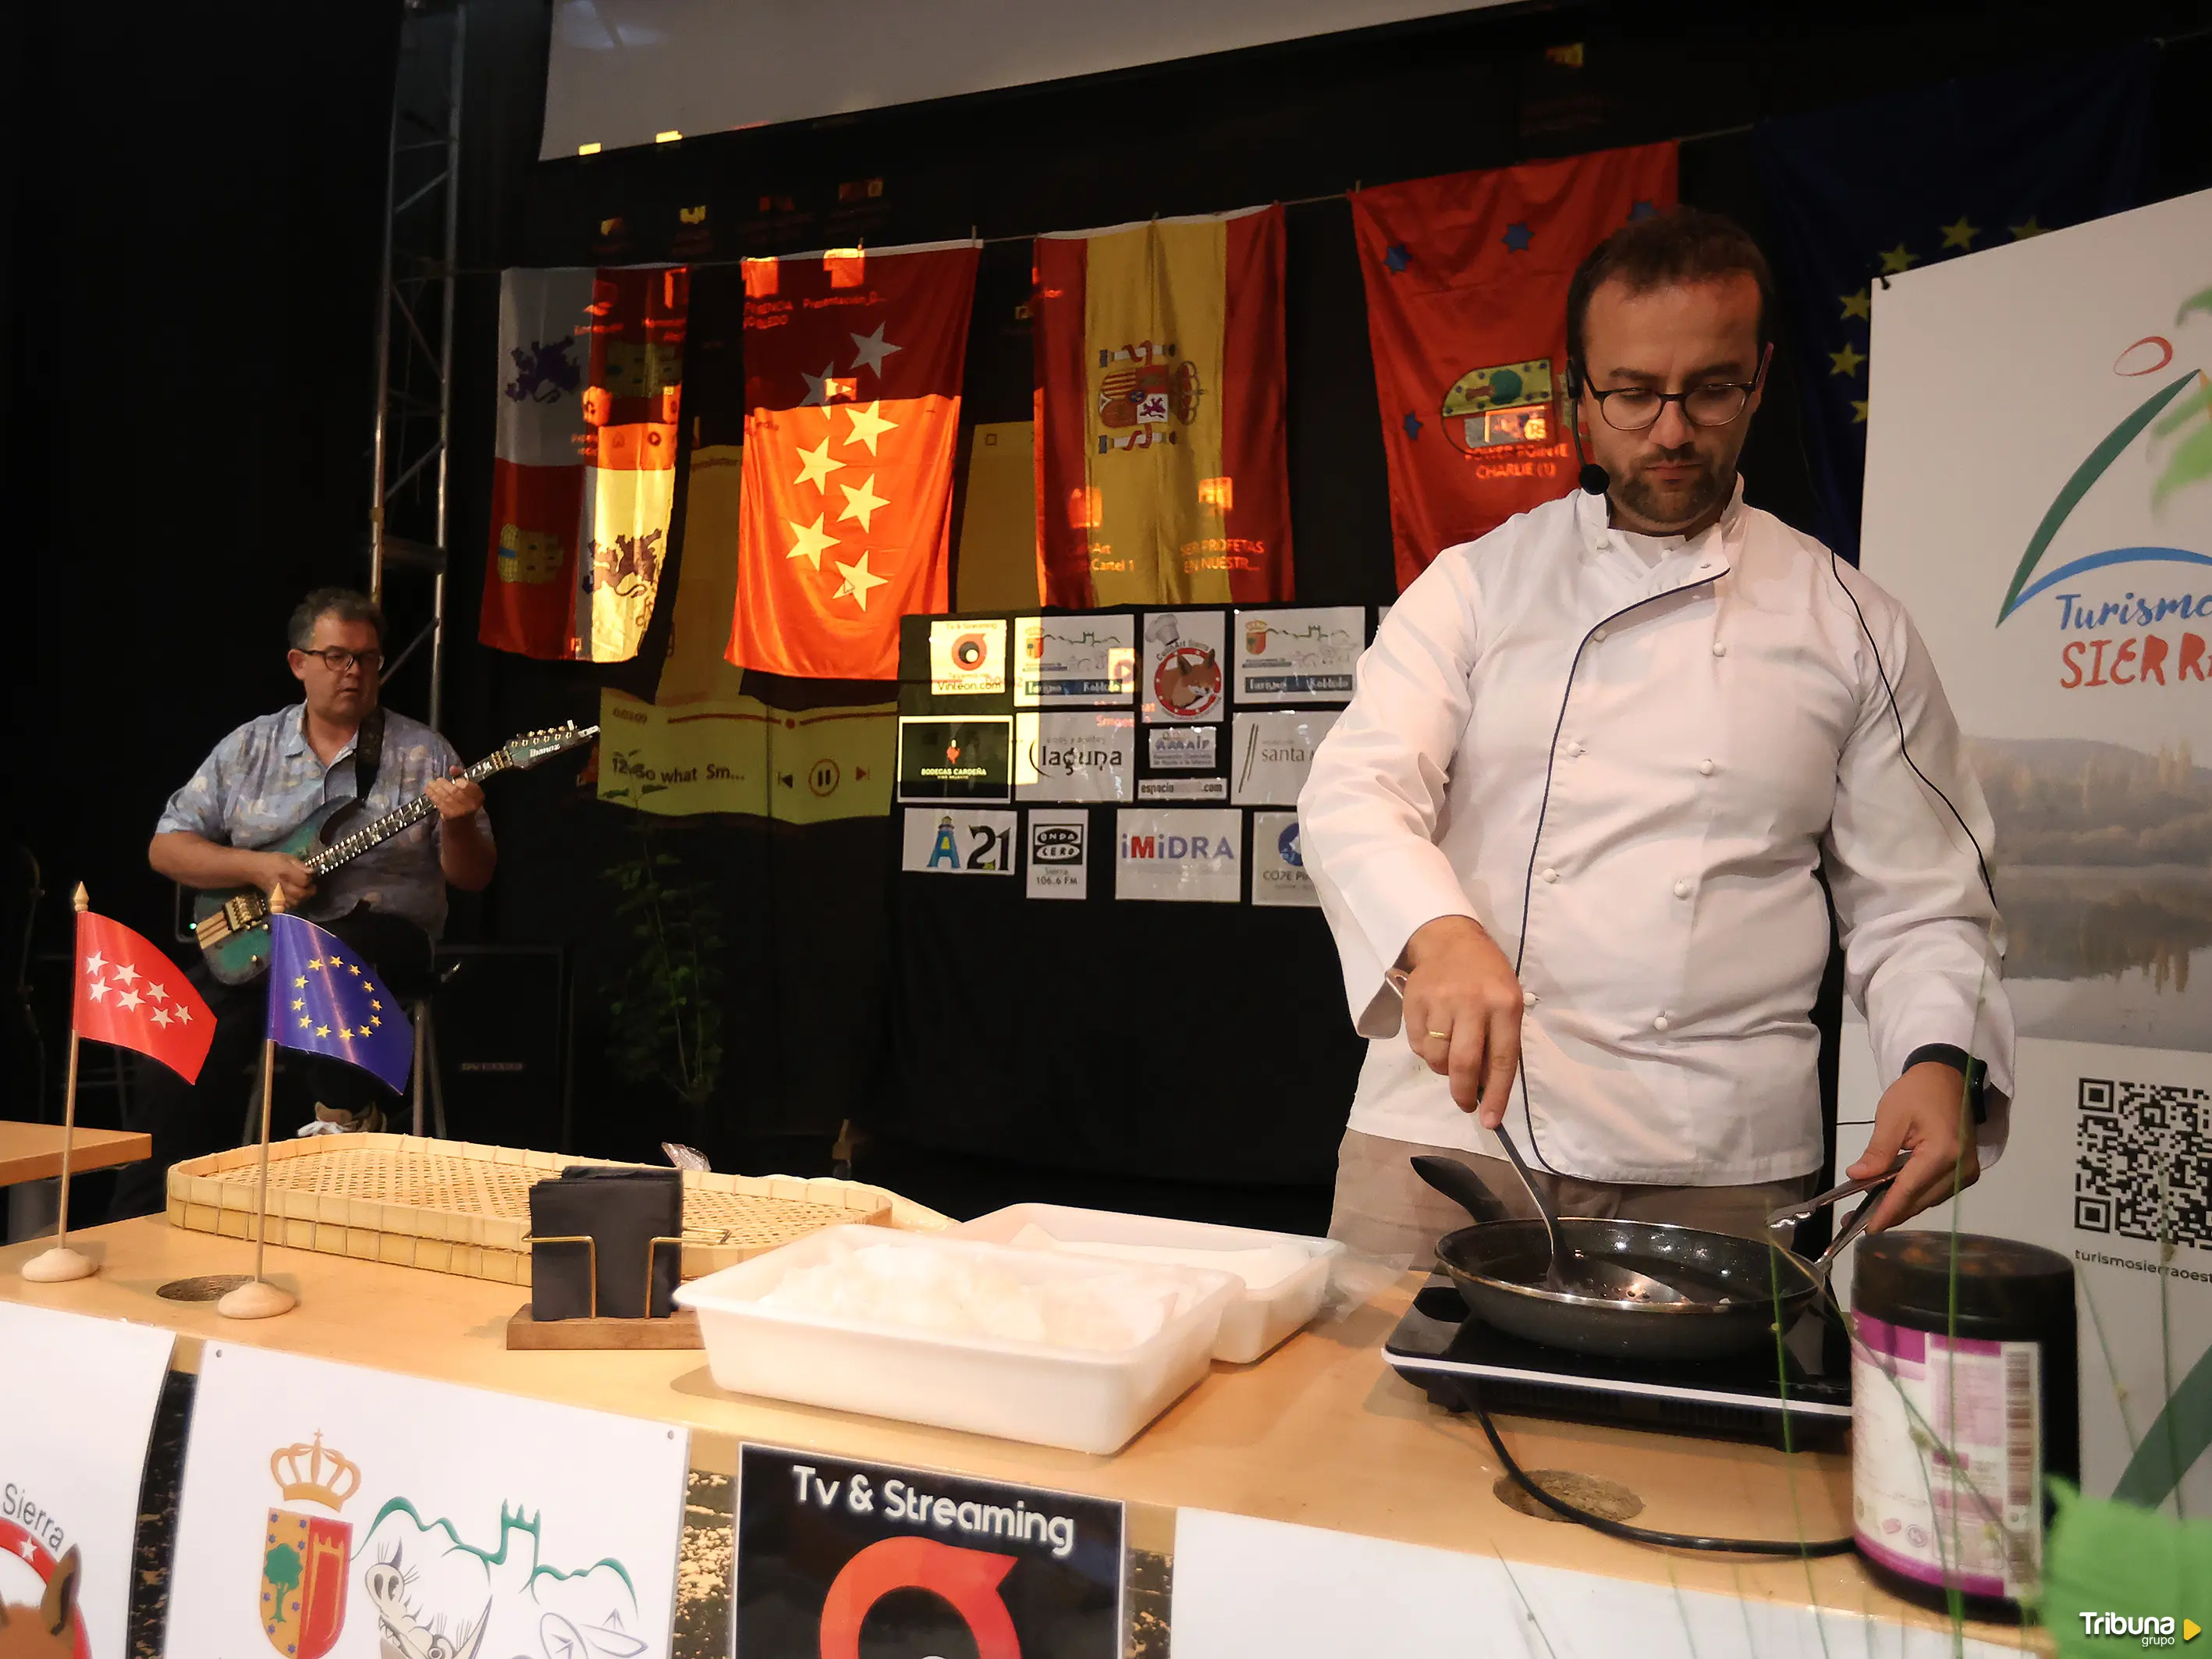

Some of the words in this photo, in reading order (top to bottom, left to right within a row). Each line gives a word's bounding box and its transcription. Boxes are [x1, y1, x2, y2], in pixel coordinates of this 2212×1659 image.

[2060, 632, 2212, 689] SIERR
[1041, 745, 1123, 776] laguna
[1261, 747, 1305, 762] santa
[661, 767, 698, 783] what
[921, 768, 952, 776] BODEGAS
[953, 767, 988, 776] CARDEÑA
[1039, 831, 1078, 842] ONDA
[1042, 846, 1076, 857] CERO
[1036, 877, 1062, 886] 106.6
[2, 1482, 66, 1553] Sierra
[791, 1464, 841, 1506] Tv
[848, 1472, 875, 1512] &
[883, 1479, 1075, 1558] Streaming
